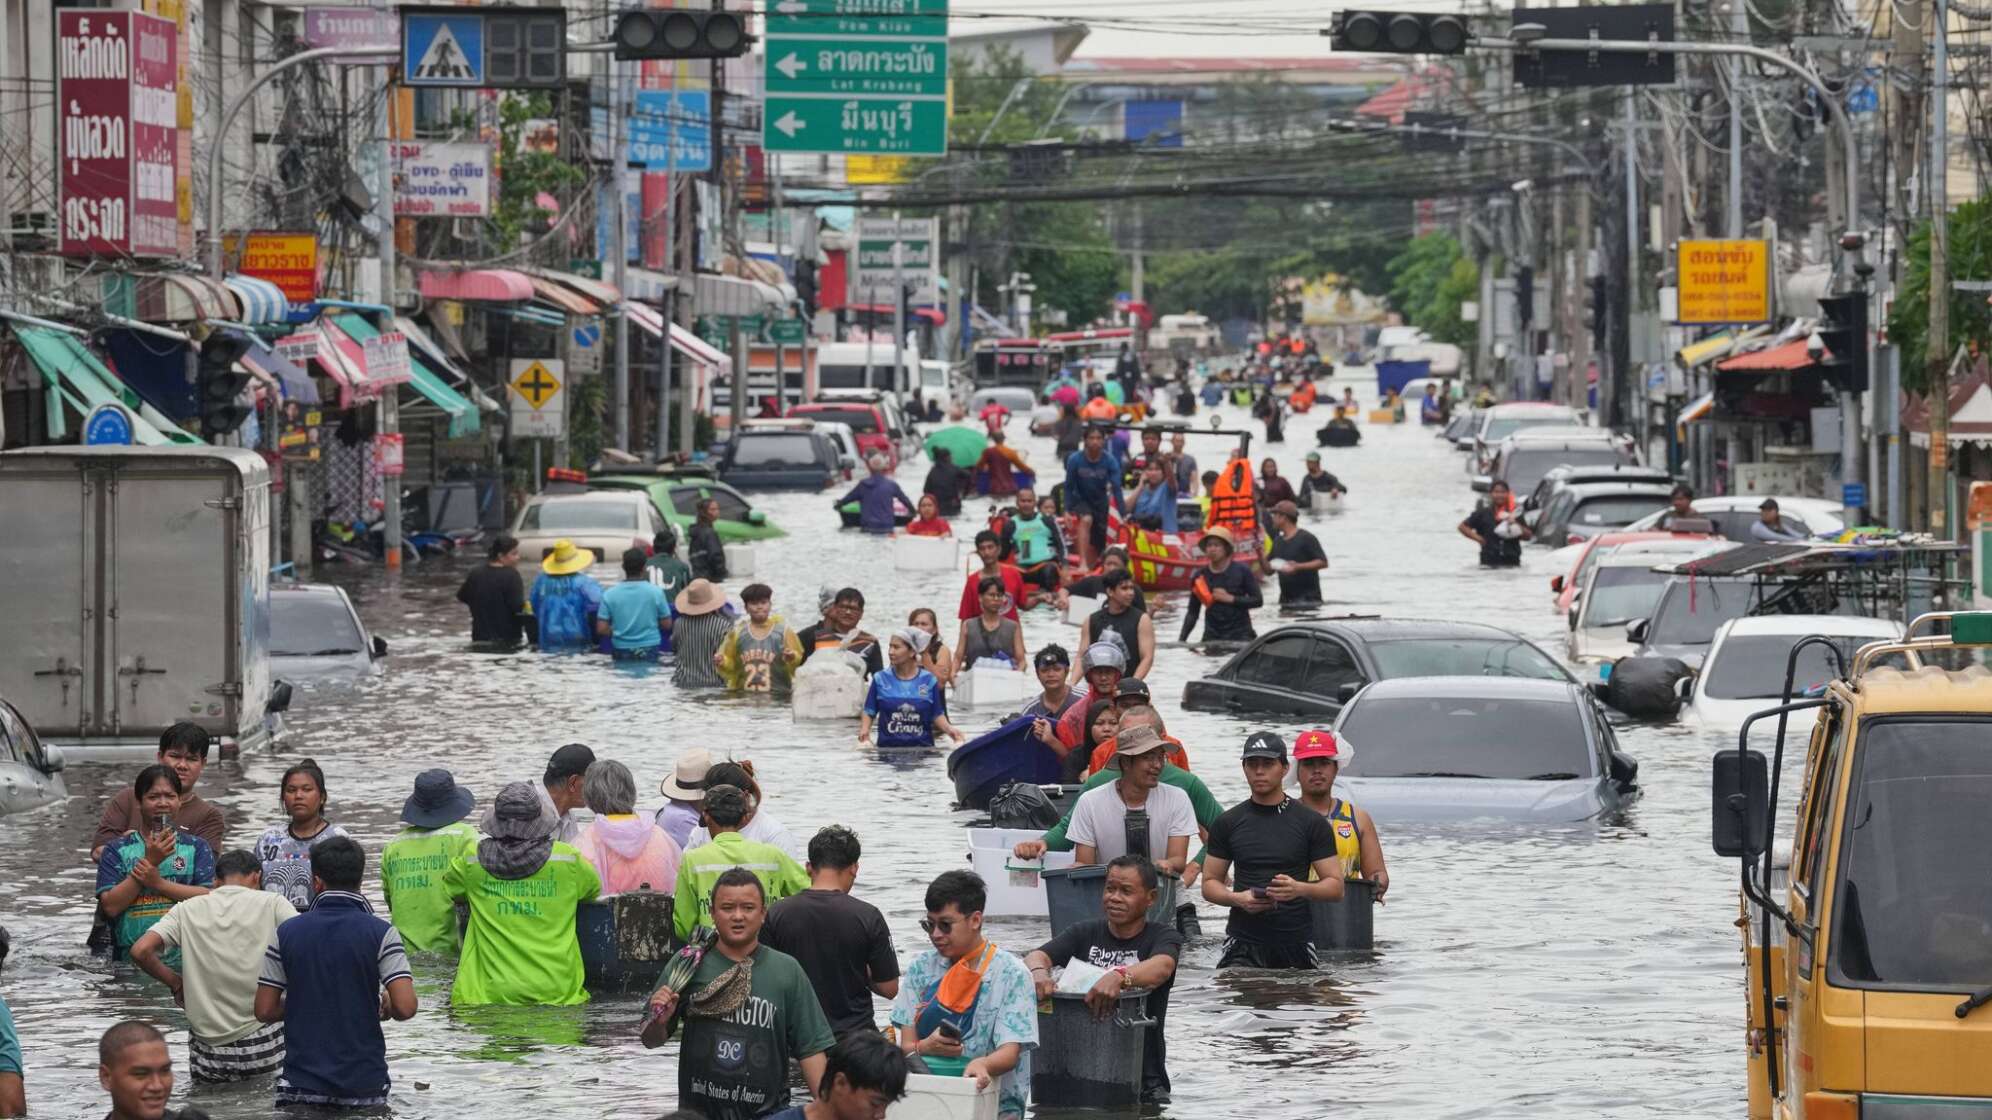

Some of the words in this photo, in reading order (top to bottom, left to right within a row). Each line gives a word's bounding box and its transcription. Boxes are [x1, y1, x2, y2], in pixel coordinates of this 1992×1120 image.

[62, 18, 127, 79] เหล็กดัด
[818, 44, 936, 73] ลาดกระบัง
[831, 79, 854, 90] Lat
[863, 80, 922, 92] Krabang
[841, 100, 913, 138] มีนบุรี
[844, 138, 867, 148] Min
[879, 138, 910, 149] Buri
[65, 197, 125, 241] กระจก
[744, 663, 771, 692] 23
[887, 721, 924, 737] Chang
[396, 875, 433, 889] กทม.
[497, 901, 542, 915] กทม.
[717, 1040, 741, 1061] DC
[707, 1081, 729, 1099] States
[731, 1085, 740, 1102] of
